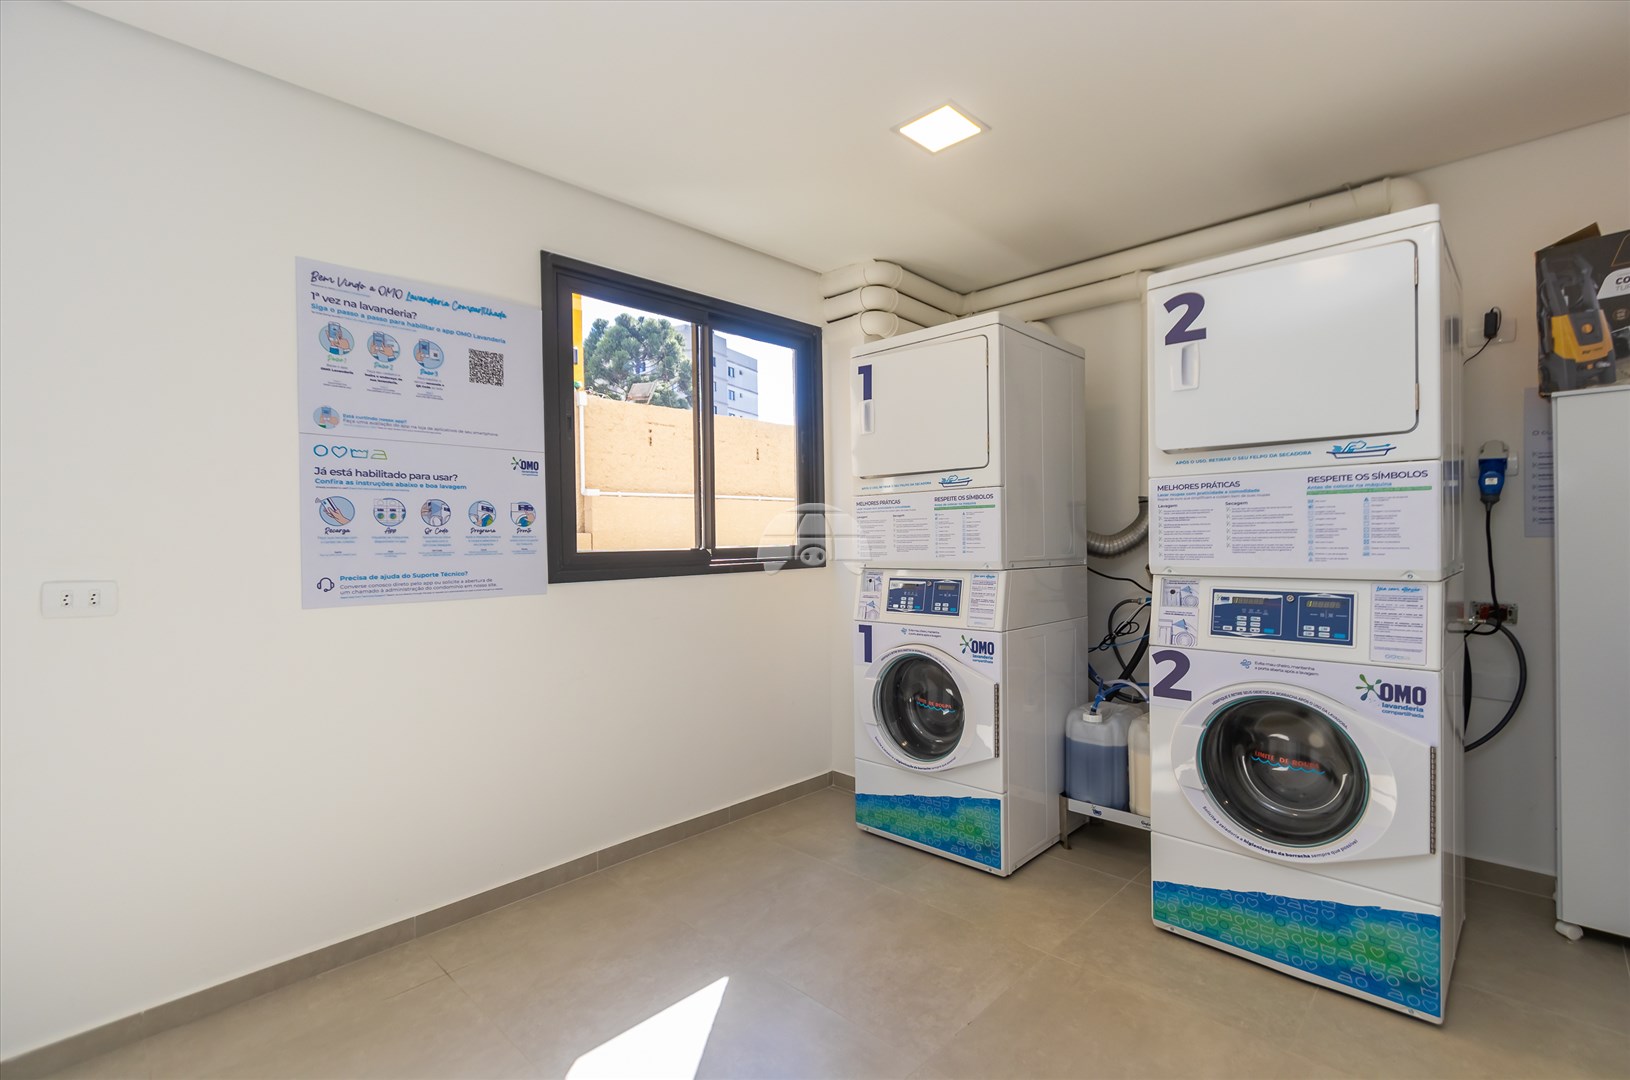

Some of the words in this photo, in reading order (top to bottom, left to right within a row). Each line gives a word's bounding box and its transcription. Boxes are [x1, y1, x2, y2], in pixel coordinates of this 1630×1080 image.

[310, 270, 334, 283] Bem
[337, 277, 366, 290] Vindo
[378, 286, 403, 300] OMO
[406, 291, 450, 306] Lavanderia
[452, 300, 507, 319] Compartilhada
[322, 295, 341, 306] vez
[343, 300, 357, 308] na
[360, 301, 417, 319] lavanderia?
[311, 303, 328, 312] Siga
[337, 309, 358, 318] passo
[366, 314, 388, 323] passo
[389, 318, 405, 326] para
[406, 321, 435, 331] habilitar
[442, 328, 455, 336] app
[456, 330, 472, 338] OMO
[473, 333, 506, 344] Lavanderia
[1163, 291, 1207, 346] 2
[858, 364, 872, 400] 1
[520, 460, 539, 471] OMO
[314, 467, 327, 475] Já
[330, 468, 352, 477] está
[355, 469, 407, 480] habilitado
[409, 473, 430, 482] para
[433, 474, 458, 482] usar?
[1307, 474, 1353, 483] RESPEITE
[1355, 472, 1370, 480] OS
[1371, 469, 1429, 480] SÍMBOLOS
[356, 479, 394, 487] instruções
[1157, 482, 1199, 492] MELHORES
[1201, 480, 1241, 489] PRÁTICAS
[324, 527, 350, 535] Recarga
[380, 573, 400, 581] ajuda
[412, 571, 439, 579] Suporte
[858, 624, 872, 663] 1
[971, 640, 994, 656] OMO
[1152, 649, 1192, 701] 2
[1380, 683, 1427, 706] OMO
[1382, 702, 1424, 712] lavanderia
[1382, 709, 1424, 719] compartilhada
[1243, 839, 1277, 855] higienização
